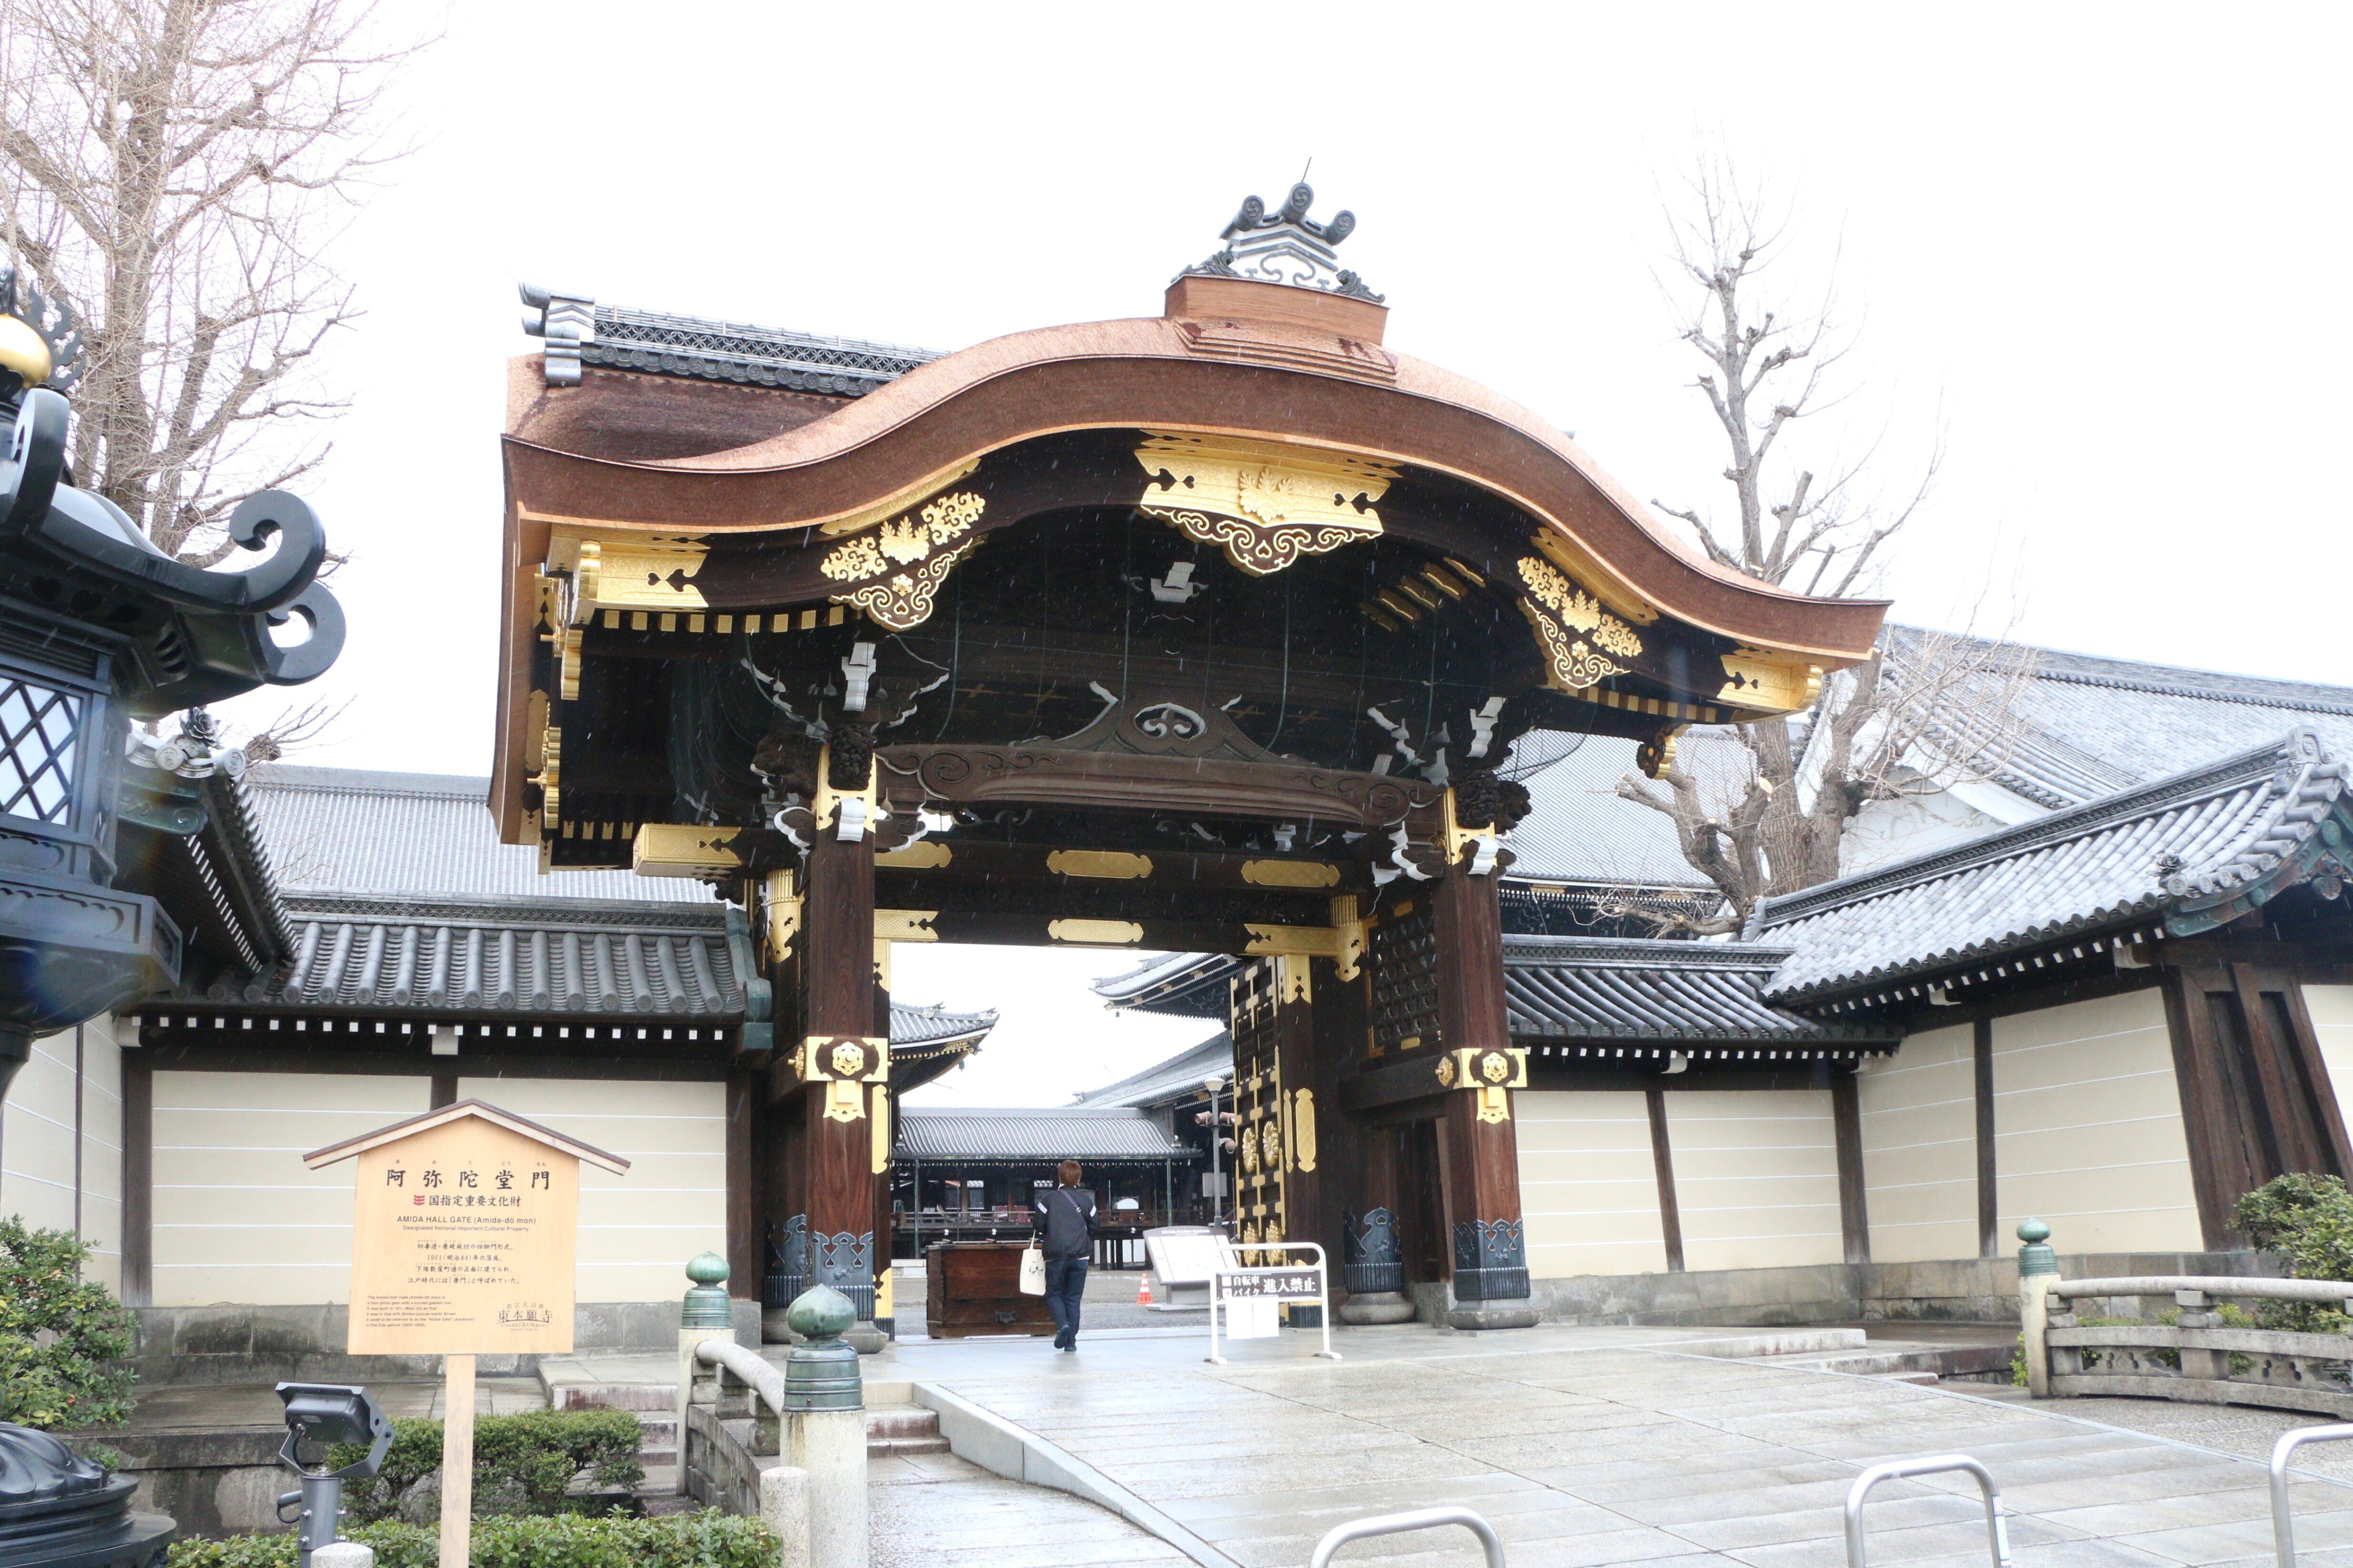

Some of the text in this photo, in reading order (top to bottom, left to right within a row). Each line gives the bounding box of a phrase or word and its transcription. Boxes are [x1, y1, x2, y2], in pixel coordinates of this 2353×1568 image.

[386, 1169, 549, 1190] 阿弥陀堂門
[429, 1194, 521, 1207] 国指定重要文化財
[1233, 1275, 1260, 1286] 自転車
[1263, 1277, 1317, 1293] 進入禁止
[496, 1309, 553, 1323] 東本願寺
